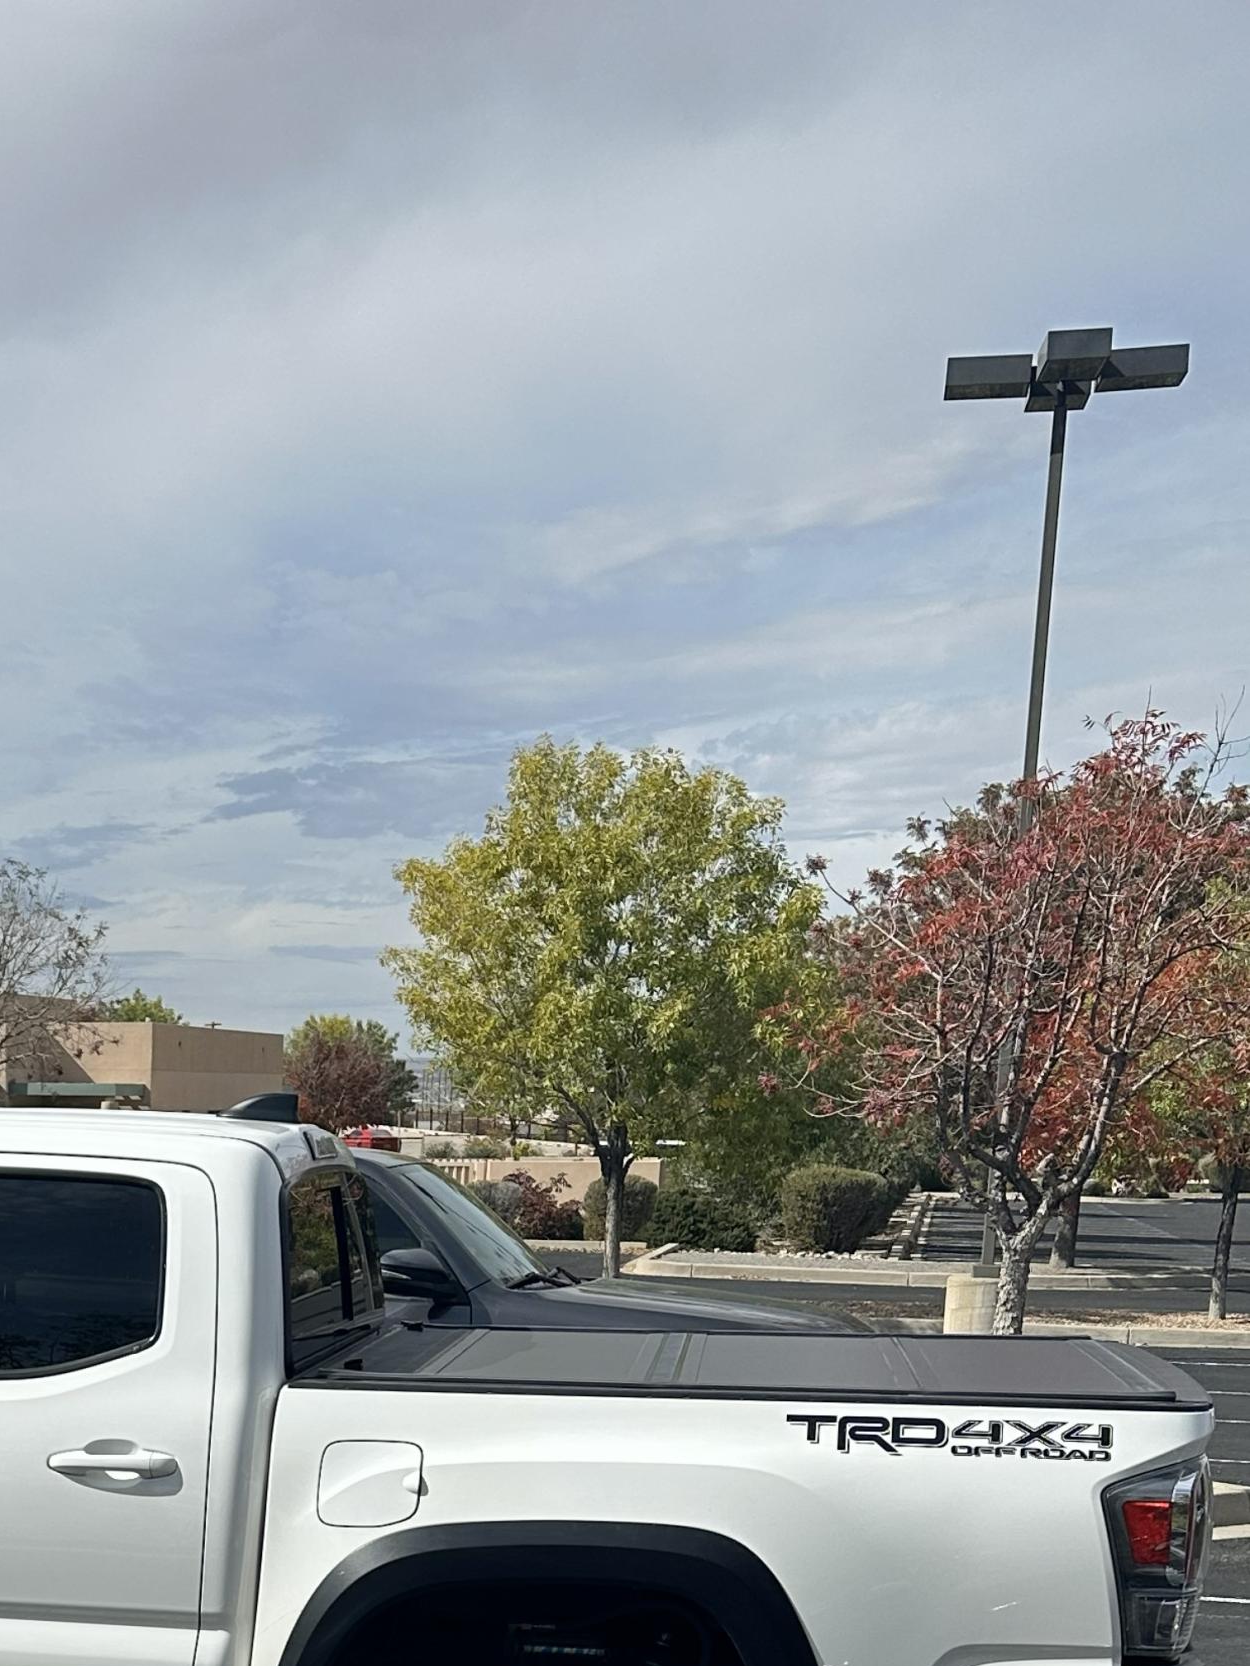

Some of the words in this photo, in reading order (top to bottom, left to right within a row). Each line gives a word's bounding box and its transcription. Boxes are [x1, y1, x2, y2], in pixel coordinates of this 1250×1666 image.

[786, 1414, 949, 1456] TRD
[950, 1444, 1016, 1458] OFF
[1020, 1446, 1112, 1462] ROAD
